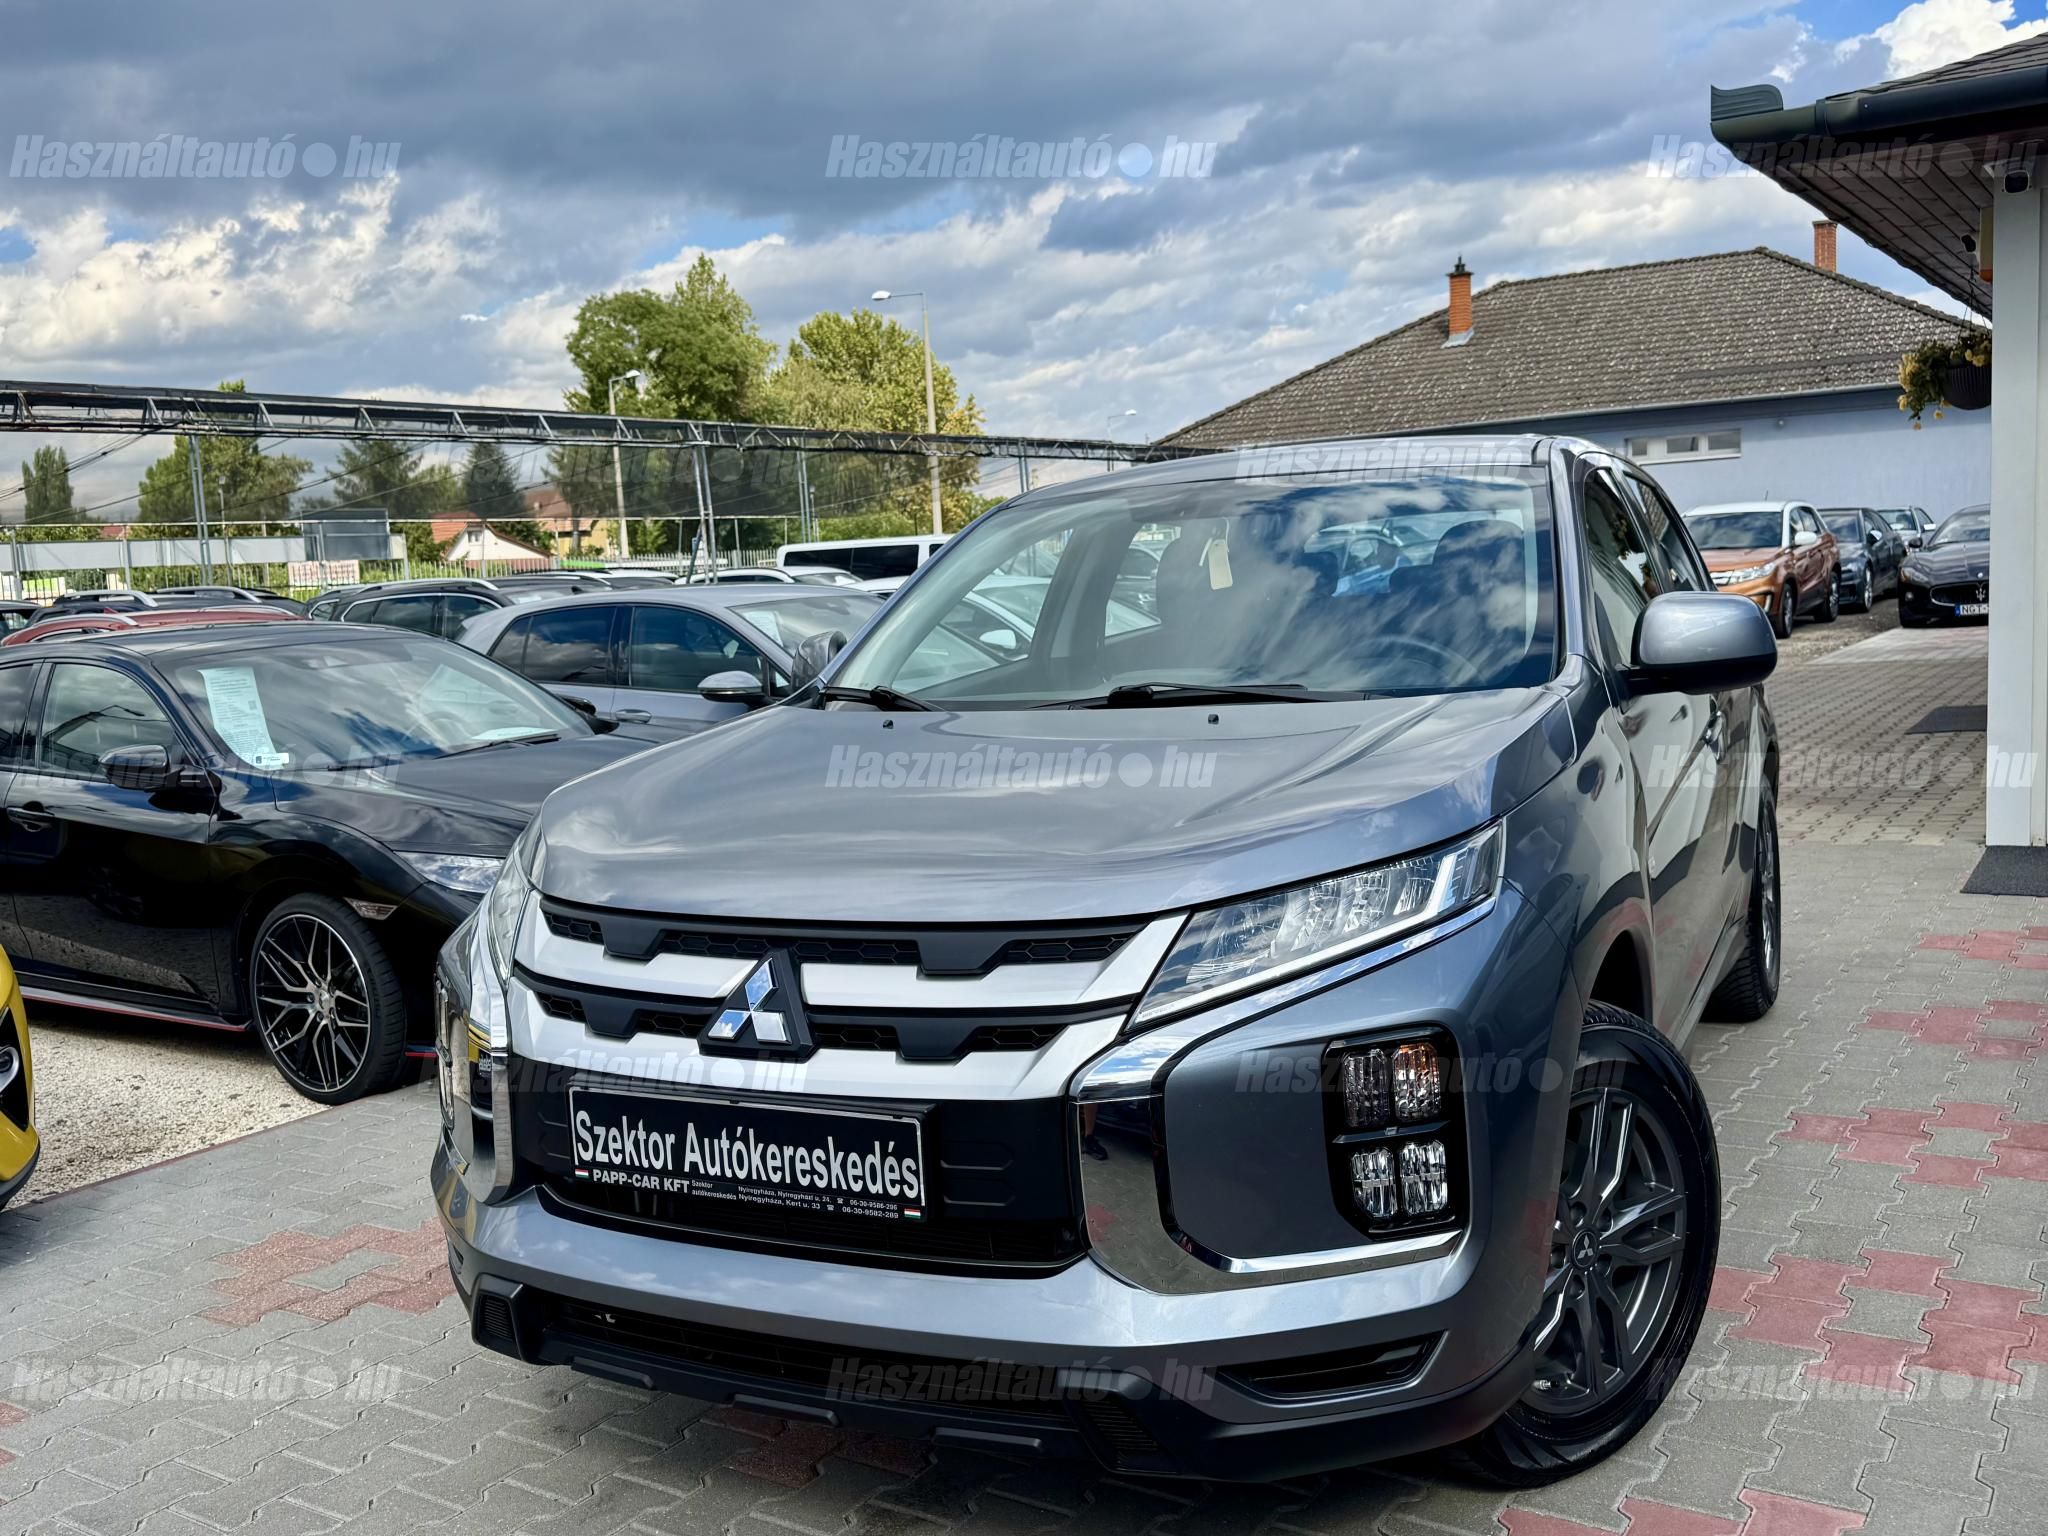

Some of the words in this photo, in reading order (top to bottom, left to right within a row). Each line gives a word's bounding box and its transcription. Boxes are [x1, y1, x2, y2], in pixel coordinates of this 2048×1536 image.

[576, 1110, 675, 1171] Szektor
[684, 1122, 919, 1198] Autókereskedés
[593, 1169, 660, 1190] PAPP-CAR
[663, 1177, 690, 1193] KFT
